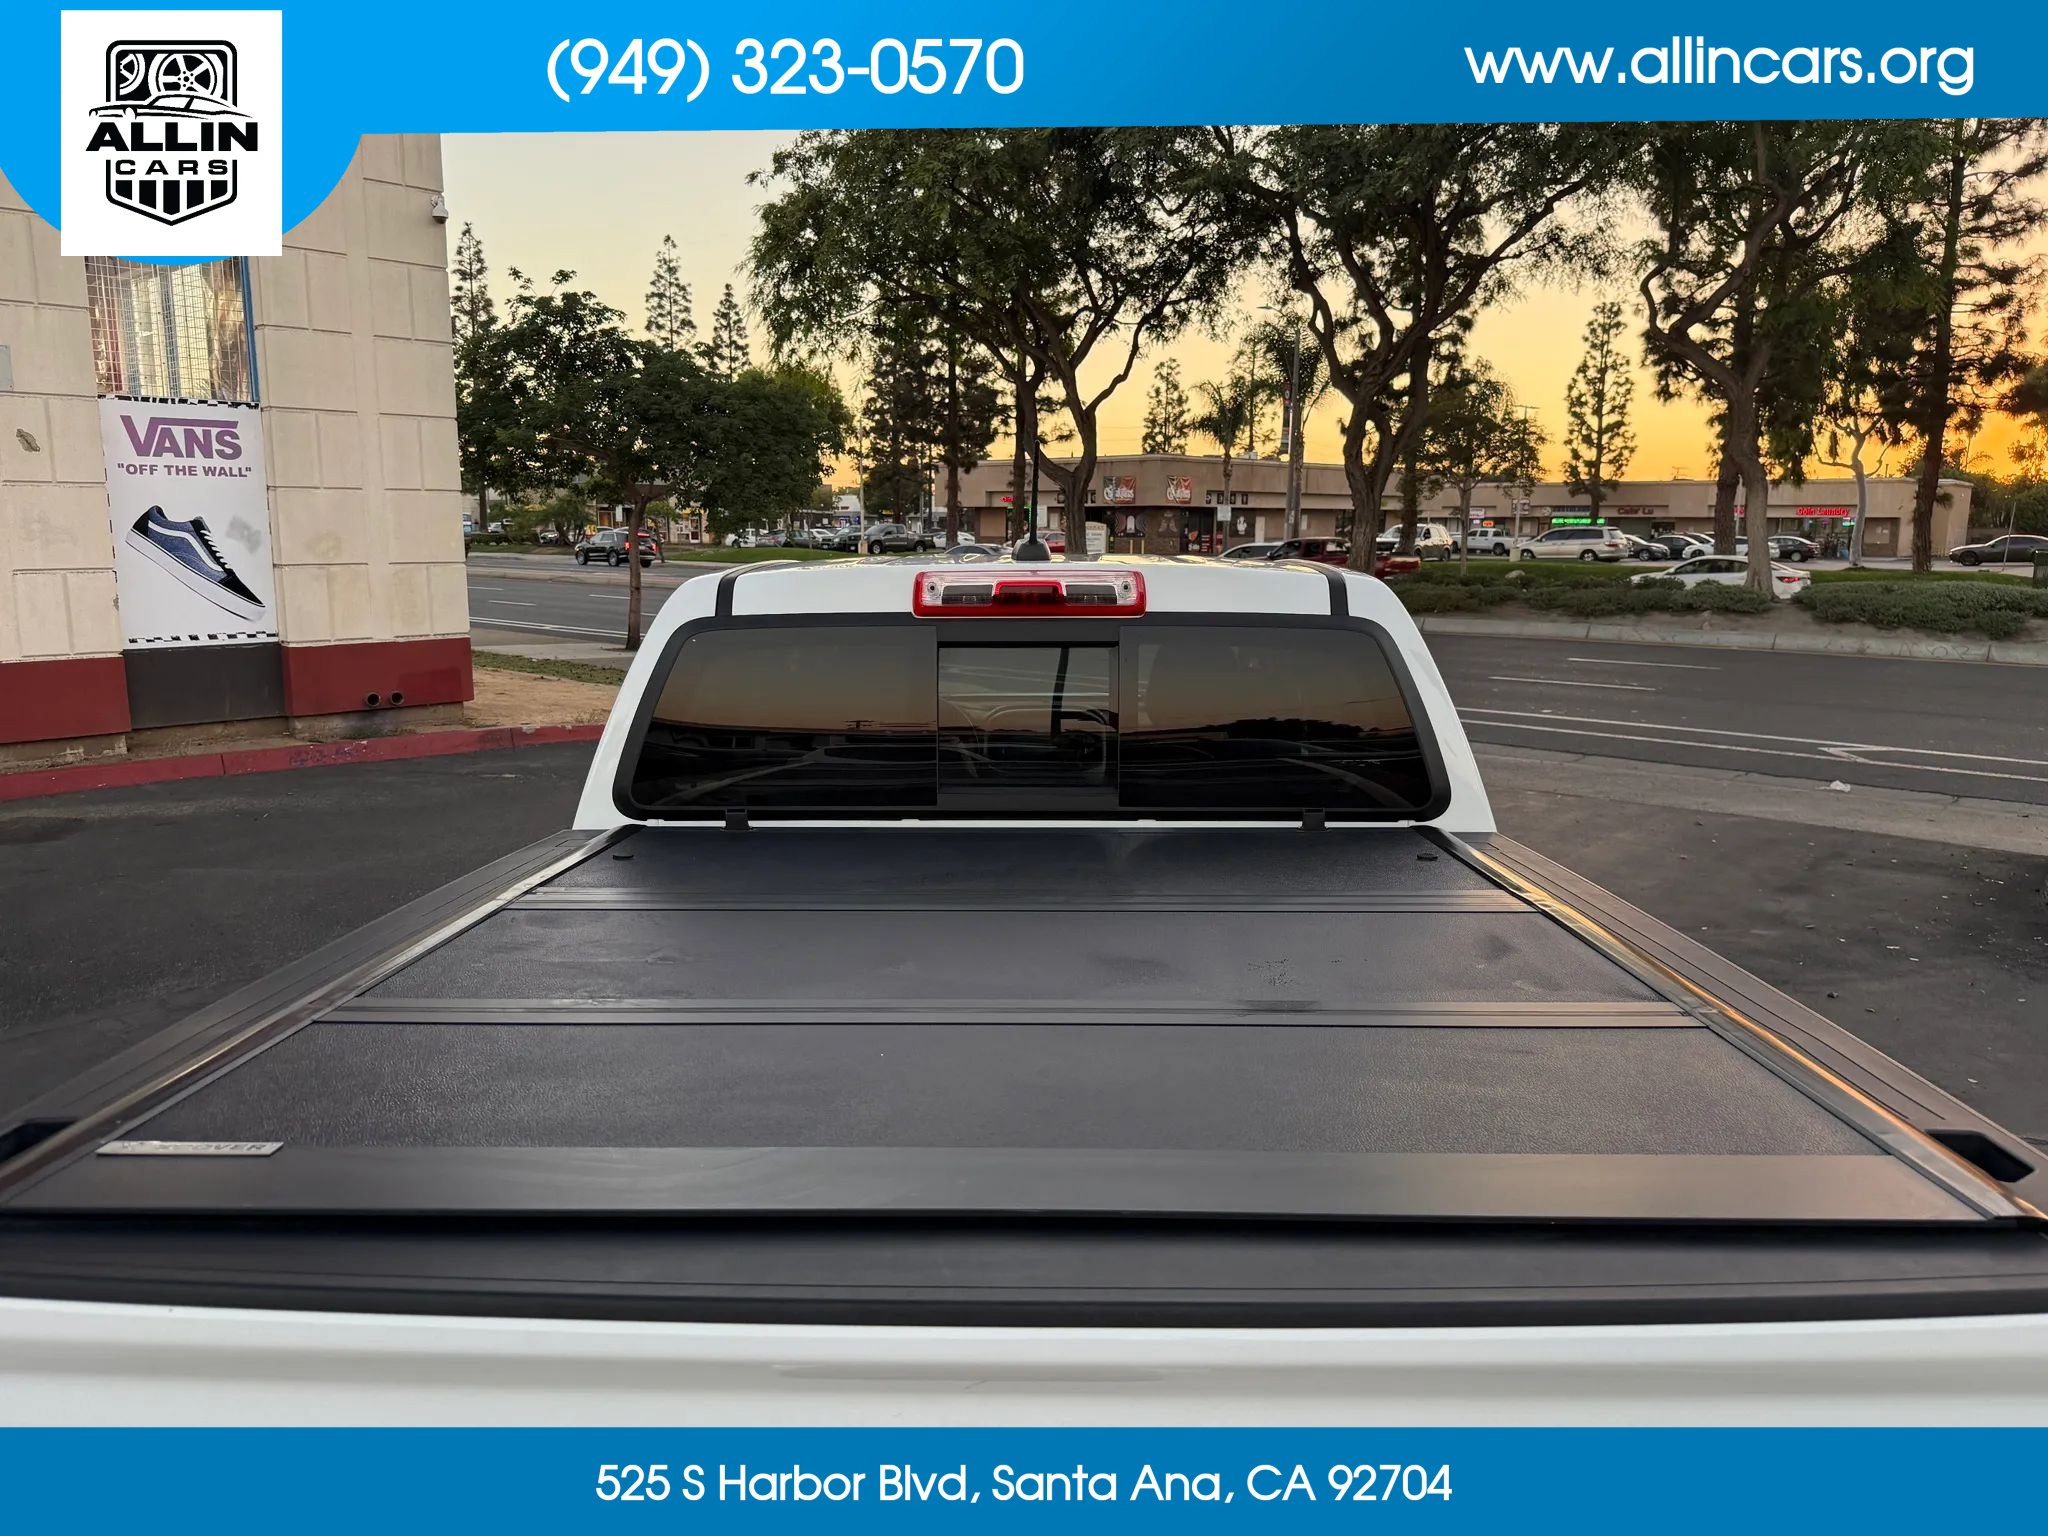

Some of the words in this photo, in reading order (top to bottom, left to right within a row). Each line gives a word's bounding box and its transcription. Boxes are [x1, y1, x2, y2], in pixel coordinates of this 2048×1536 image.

[120, 415, 242, 460] VANS
[117, 463, 159, 475] "OFF
[164, 465, 198, 477] THE
[203, 466, 252, 477] WALL"
[1816, 507, 1850, 517] Laundry
